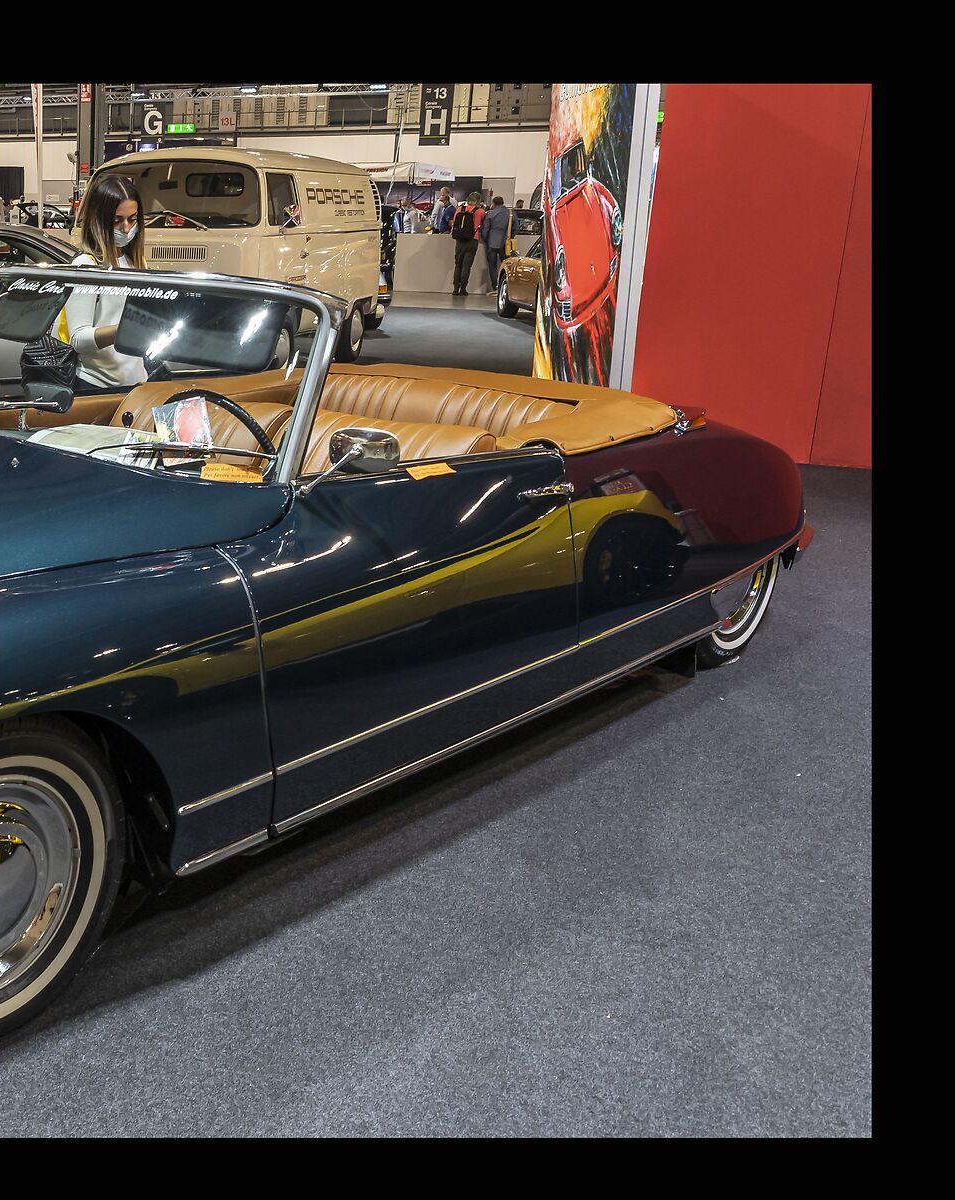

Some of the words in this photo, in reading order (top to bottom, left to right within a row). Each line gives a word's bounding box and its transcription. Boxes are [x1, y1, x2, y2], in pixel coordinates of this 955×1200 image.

[434, 87, 448, 99] 13
[143, 111, 163, 135] G
[220, 117, 235, 126] 13L
[424, 109, 448, 136] H
[305, 188, 365, 205] PORSCHE
[8, 277, 41, 292] Classic
[38, 280, 66, 294] Cars
[73, 285, 178, 300] www.omautomobile.de
